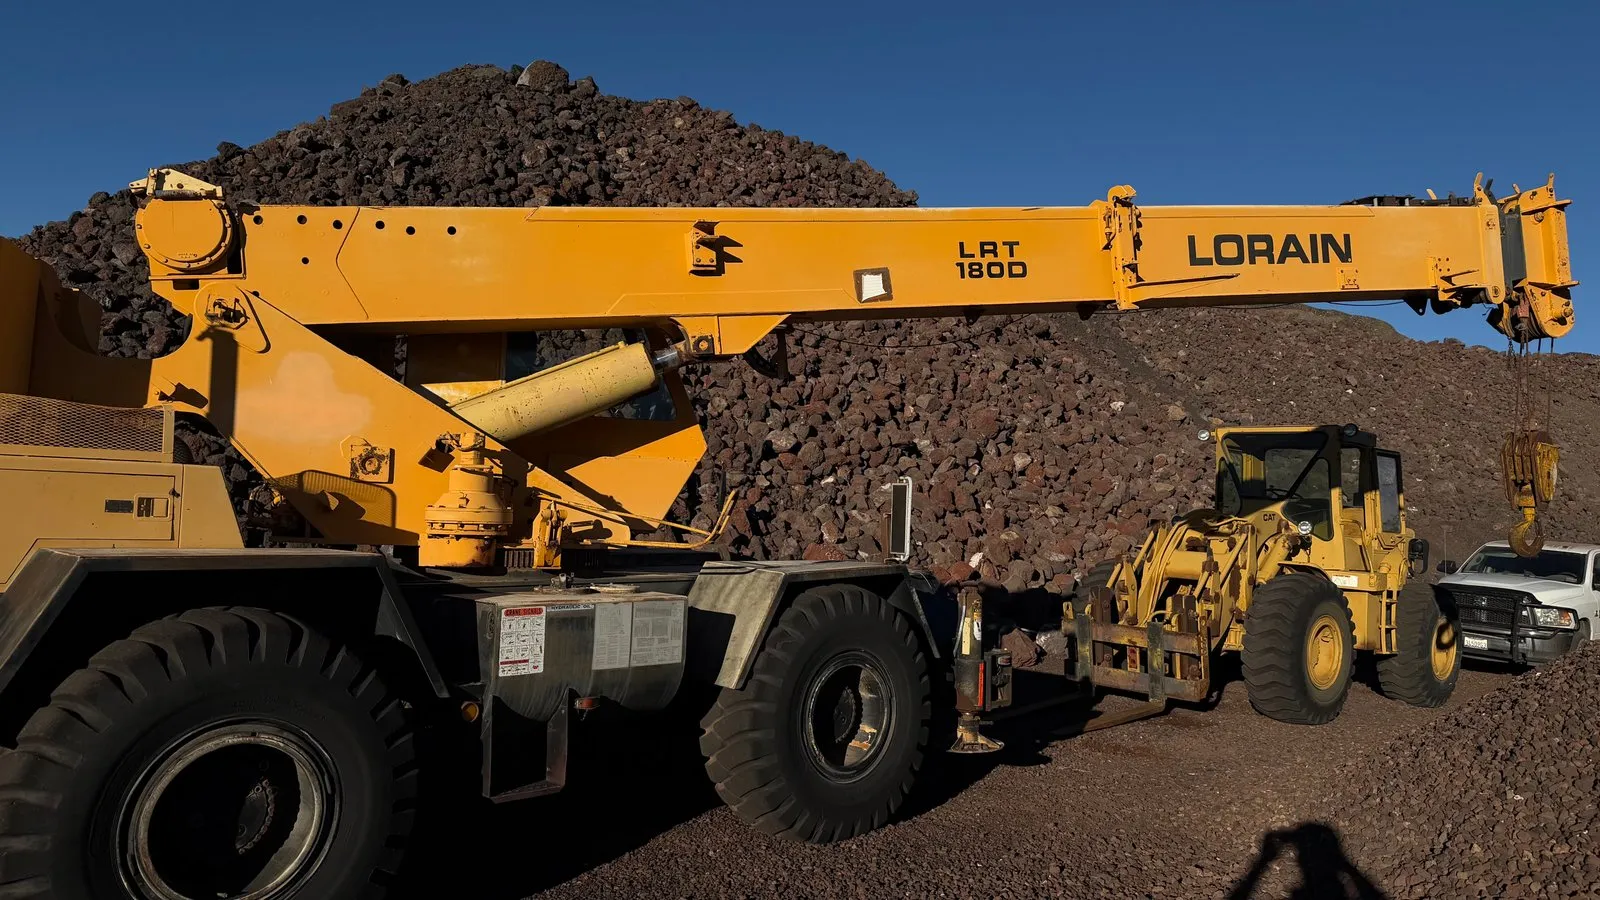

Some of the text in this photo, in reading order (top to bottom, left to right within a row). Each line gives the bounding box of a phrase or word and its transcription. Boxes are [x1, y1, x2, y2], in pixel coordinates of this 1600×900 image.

[958, 241, 1020, 258] LRT
[1187, 233, 1353, 266] LORAIN
[955, 261, 1028, 279] 180D
[1262, 513, 1276, 522] CAT
